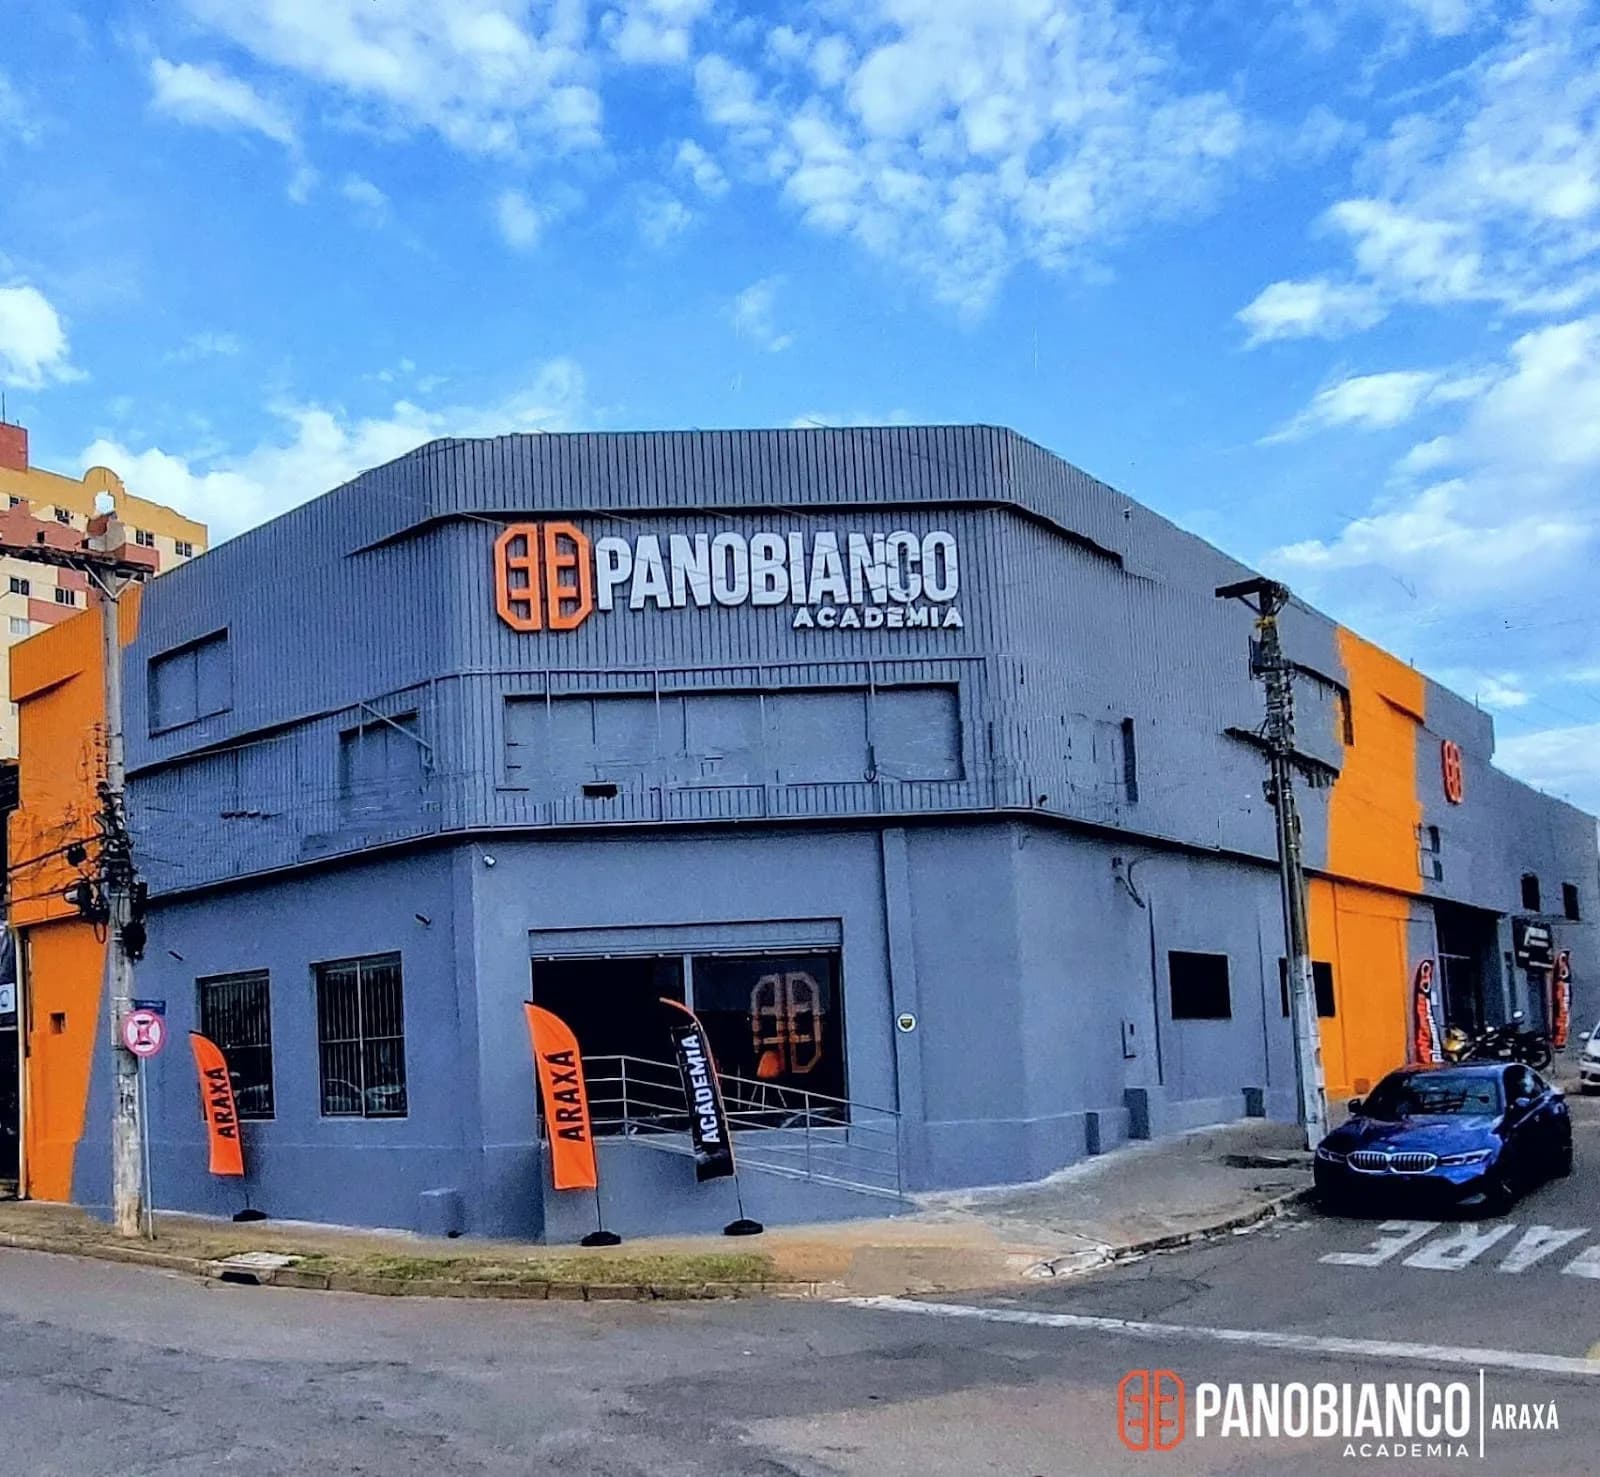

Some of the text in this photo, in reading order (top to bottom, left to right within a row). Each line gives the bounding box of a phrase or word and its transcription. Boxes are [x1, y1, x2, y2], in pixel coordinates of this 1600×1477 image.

[595, 529, 960, 611] PANOBIANCO
[793, 606, 965, 630] ACADEMIA
[203, 1067, 236, 1139] ARAXÁ
[542, 1049, 586, 1142] ARAXÁ
[680, 1033, 721, 1144] ACADEMIA
